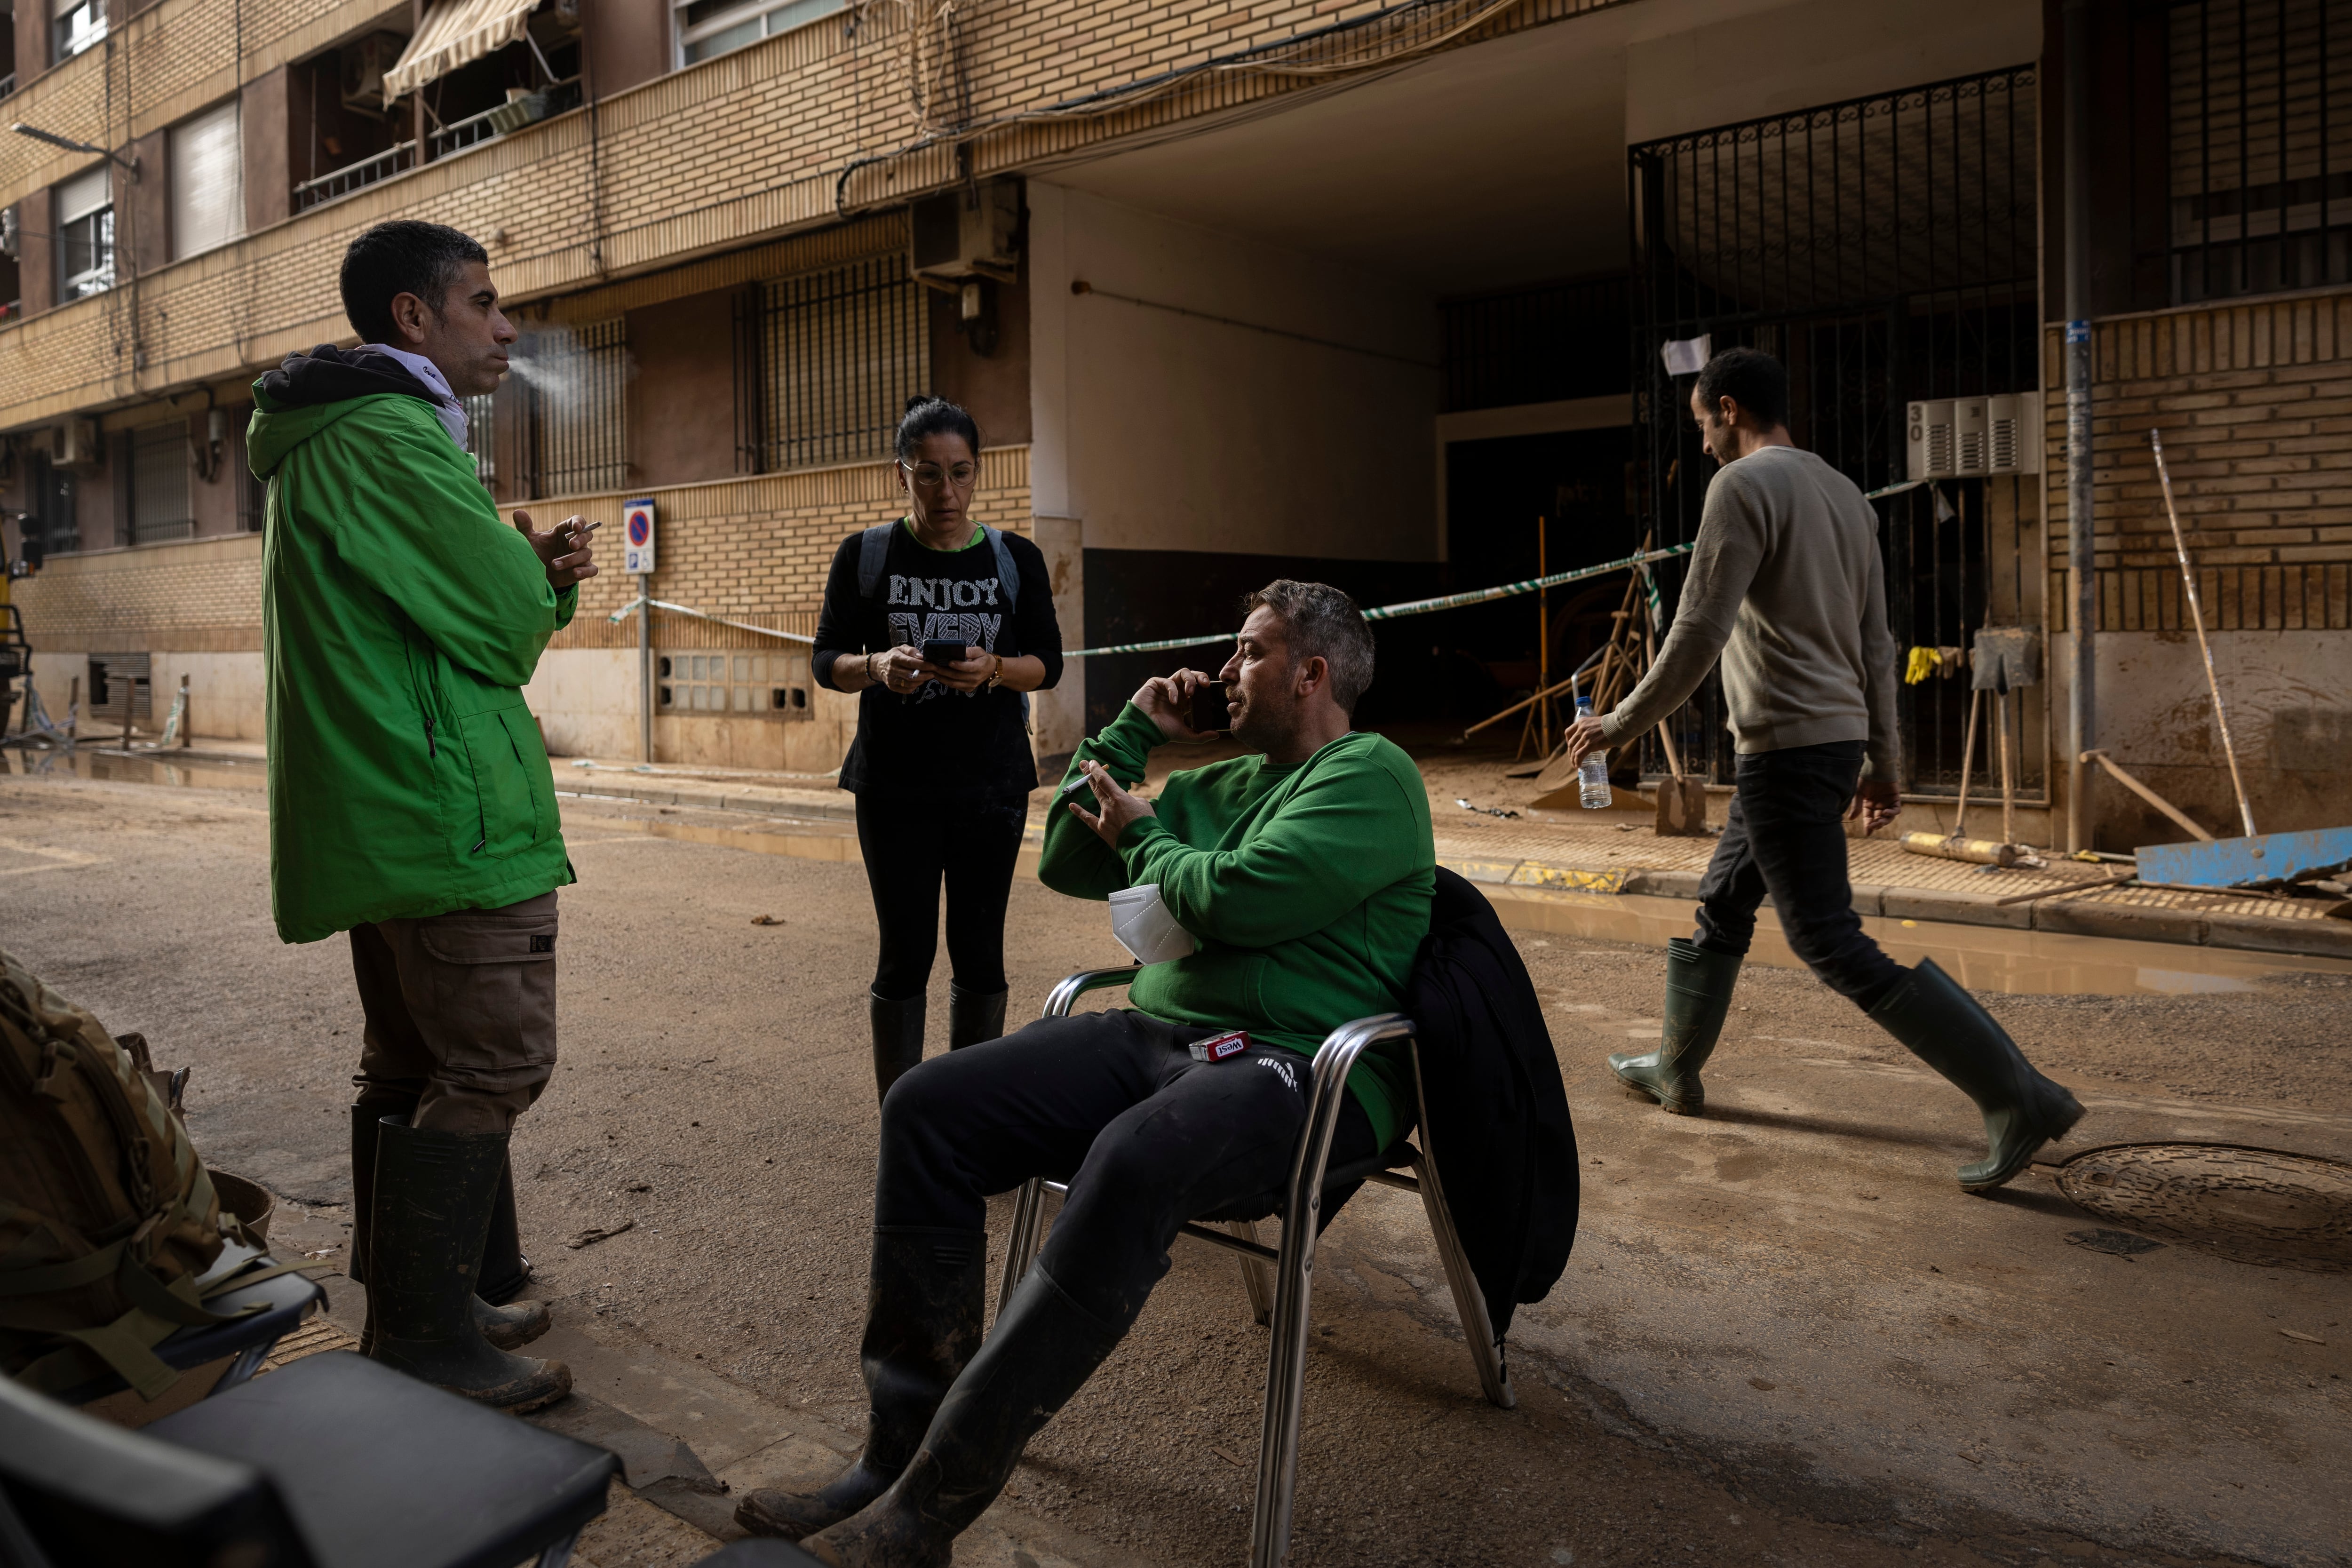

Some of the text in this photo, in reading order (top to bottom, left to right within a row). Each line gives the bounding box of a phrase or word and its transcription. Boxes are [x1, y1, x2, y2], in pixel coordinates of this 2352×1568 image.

[887, 574, 998, 611] ENJOY
[888, 613, 1001, 653] EVERY
[1218, 1041, 1242, 1054] West
